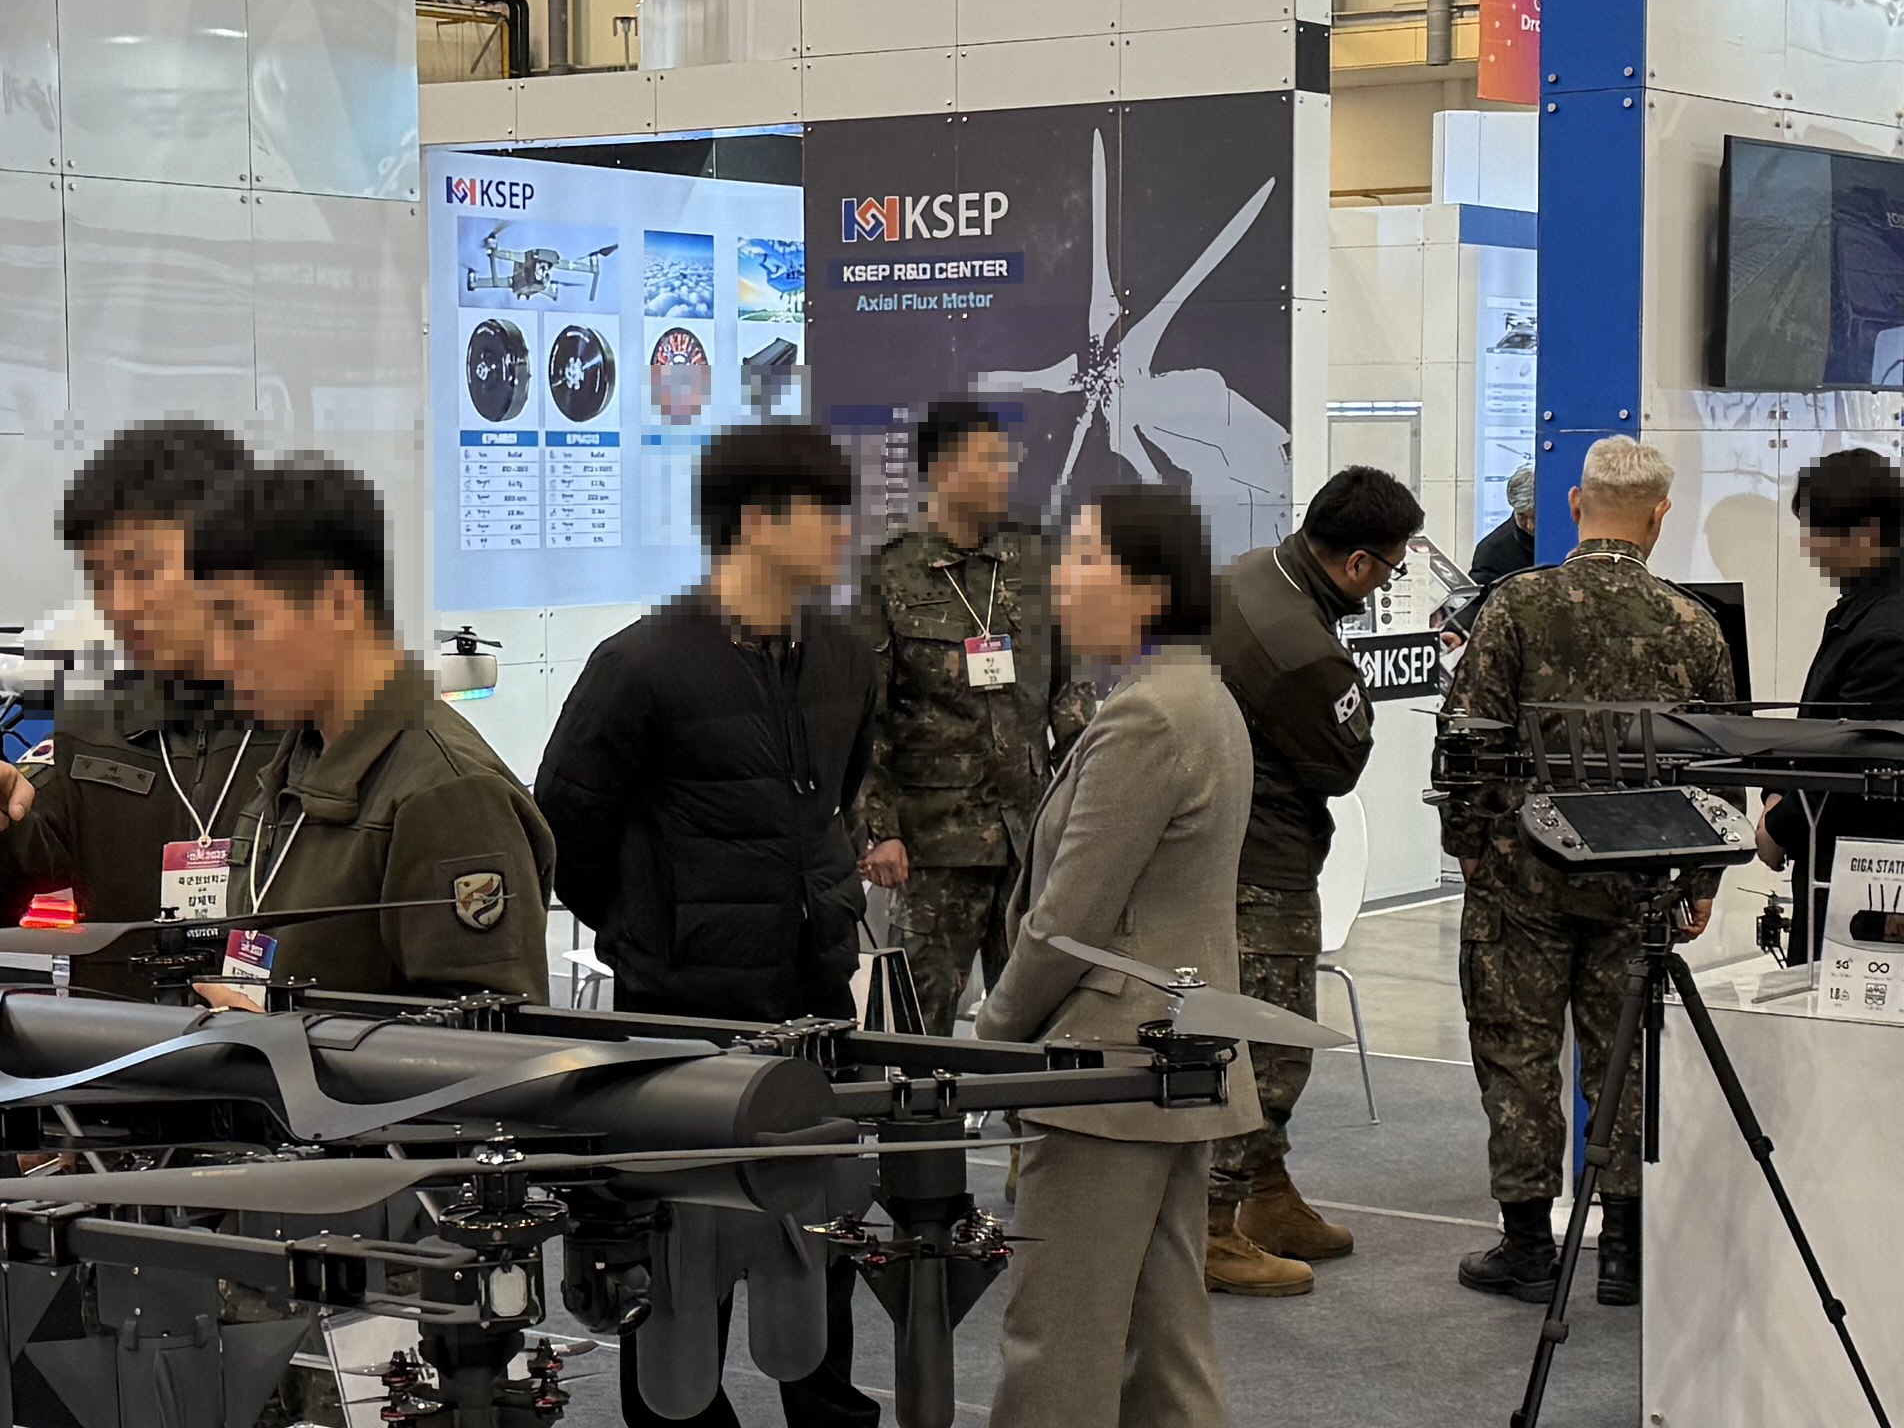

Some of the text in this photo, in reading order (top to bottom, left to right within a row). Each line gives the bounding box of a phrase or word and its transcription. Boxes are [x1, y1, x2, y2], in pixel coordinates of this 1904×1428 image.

[480, 179, 535, 210] KSEP
[904, 191, 1010, 240] KSEP
[842, 259, 1009, 283] KSEP R&D CENTER
[856, 291, 994, 312] Axial Flux Motor
[1384, 645, 1436, 687] KSEP
[1850, 857, 1874, 873] GIGA
